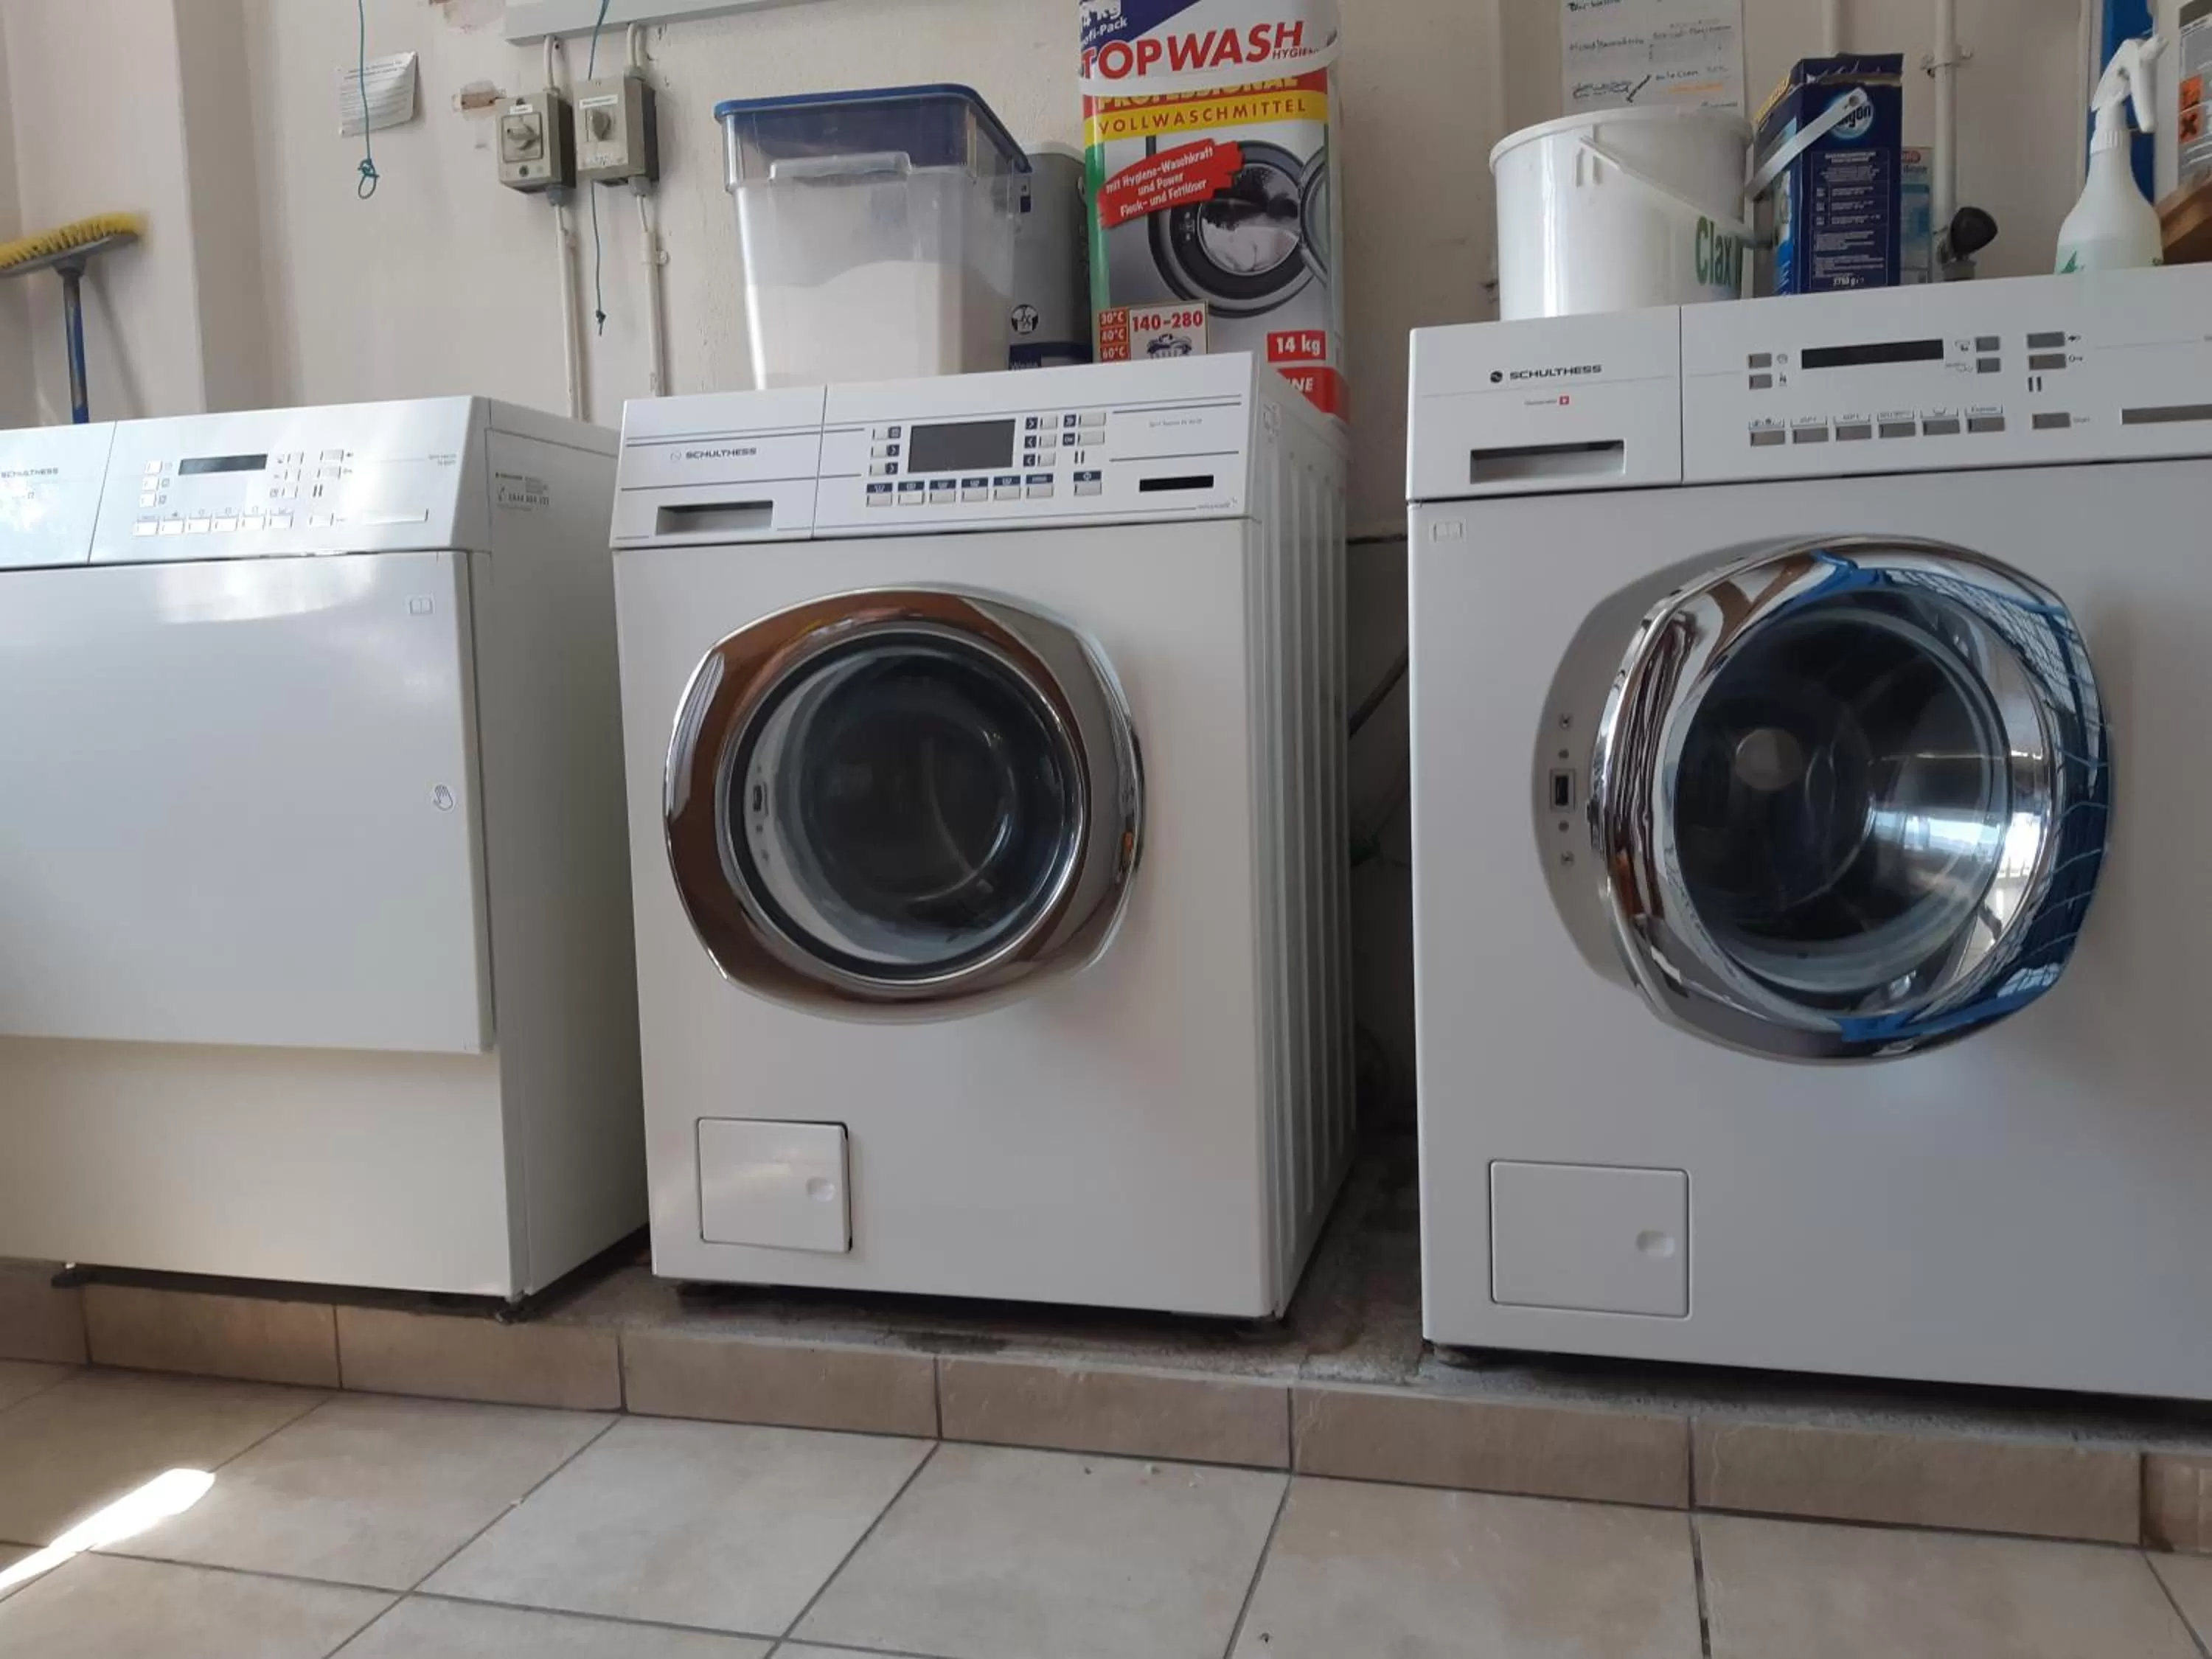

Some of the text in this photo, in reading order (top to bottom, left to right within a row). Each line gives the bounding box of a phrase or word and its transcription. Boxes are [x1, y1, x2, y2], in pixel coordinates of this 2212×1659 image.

[1081, 20, 1304, 80] TOPWASH
[1099, 98, 1306, 135] VOLLWASCHMITTEL
[1105, 180, 1120, 194] mit
[1138, 173, 1184, 195] und Power
[1150, 191, 1167, 206] und
[1695, 215, 1732, 288] Clax
[1132, 310, 1203, 332] 140-280
[1276, 333, 1321, 356] 14 kg
[1509, 364, 1603, 380] SCHULTHESS
[1287, 376, 1314, 393] NE
[685, 447, 757, 460] SCHULTHESS
